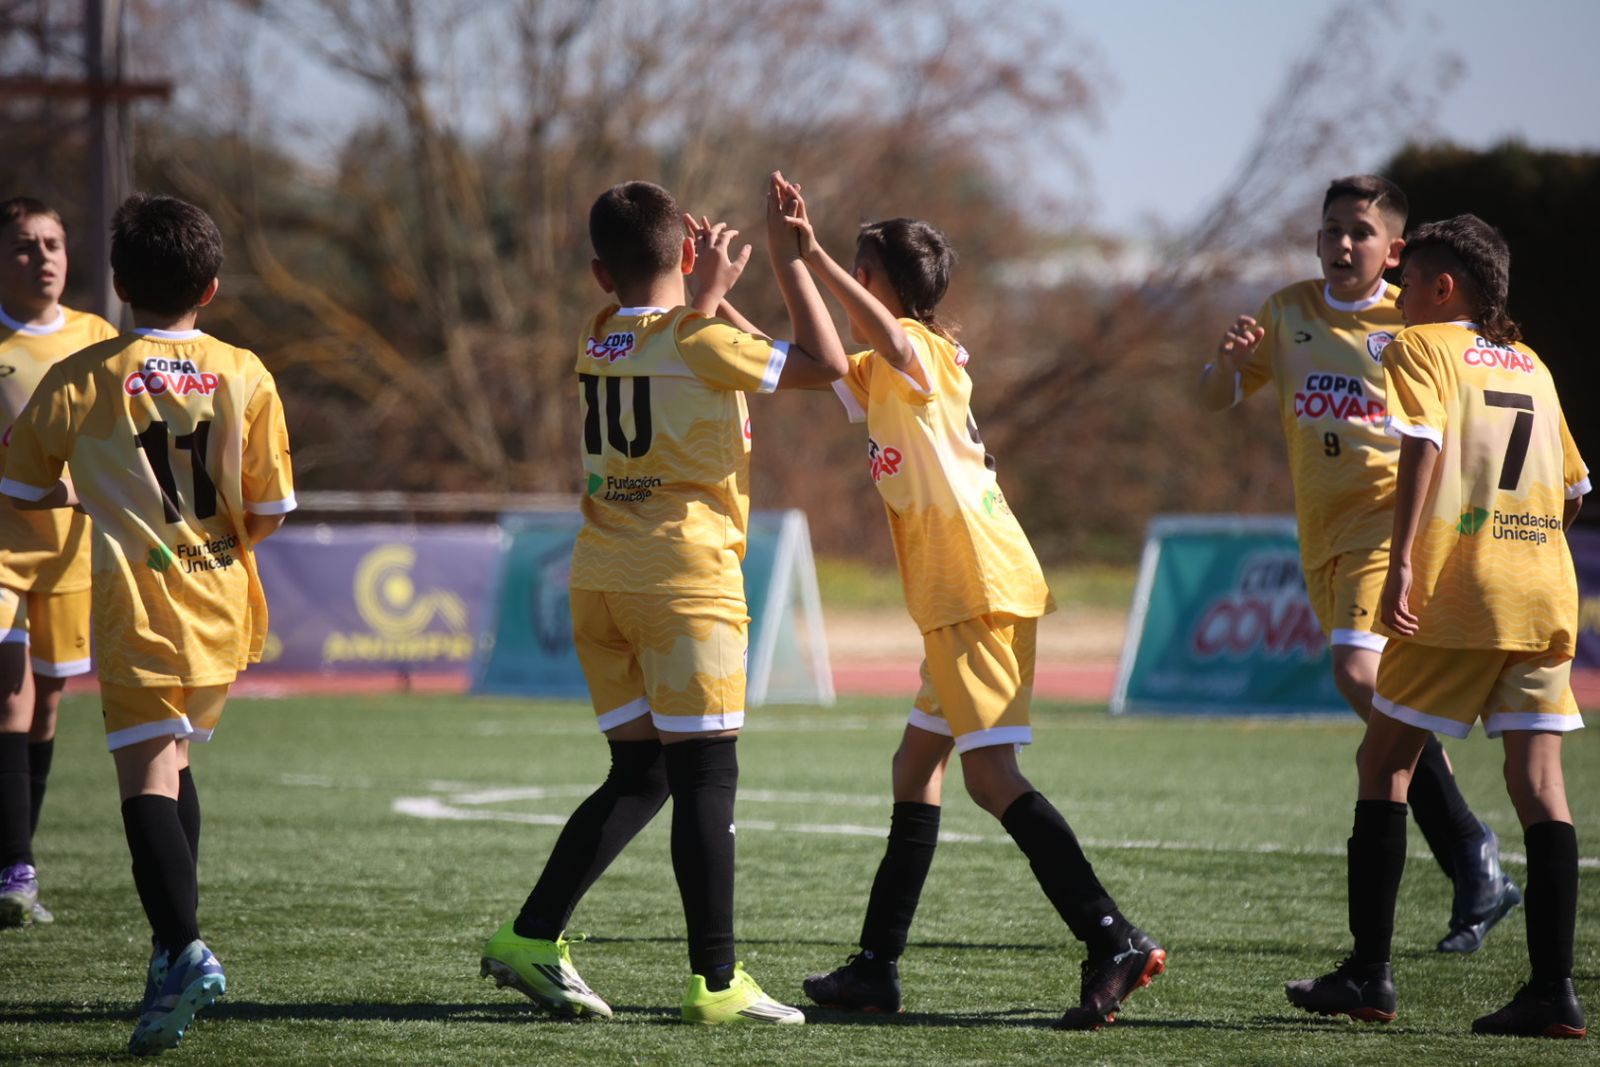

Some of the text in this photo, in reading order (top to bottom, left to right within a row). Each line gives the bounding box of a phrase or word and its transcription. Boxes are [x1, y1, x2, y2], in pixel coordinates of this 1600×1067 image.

[603, 333, 634, 347] COPA
[1475, 337, 1515, 353] CO
[145, 358, 196, 374] COPA
[1463, 348, 1535, 373] COVAP
[124, 371, 219, 396] COVAP
[1306, 375, 1362, 397] COPA
[579, 373, 652, 458] 10
[1295, 392, 1387, 422] COVAP
[1324, 432, 1341, 457] 9
[1483, 390, 1534, 491] 7
[134, 420, 217, 524] 11
[604, 489, 652, 503] Unicaja
[176, 533, 237, 559] Fundació
[1492, 525, 1547, 546] Unicaja
[180, 552, 233, 574] Unicaja
[1193, 598, 1326, 657] COVA
